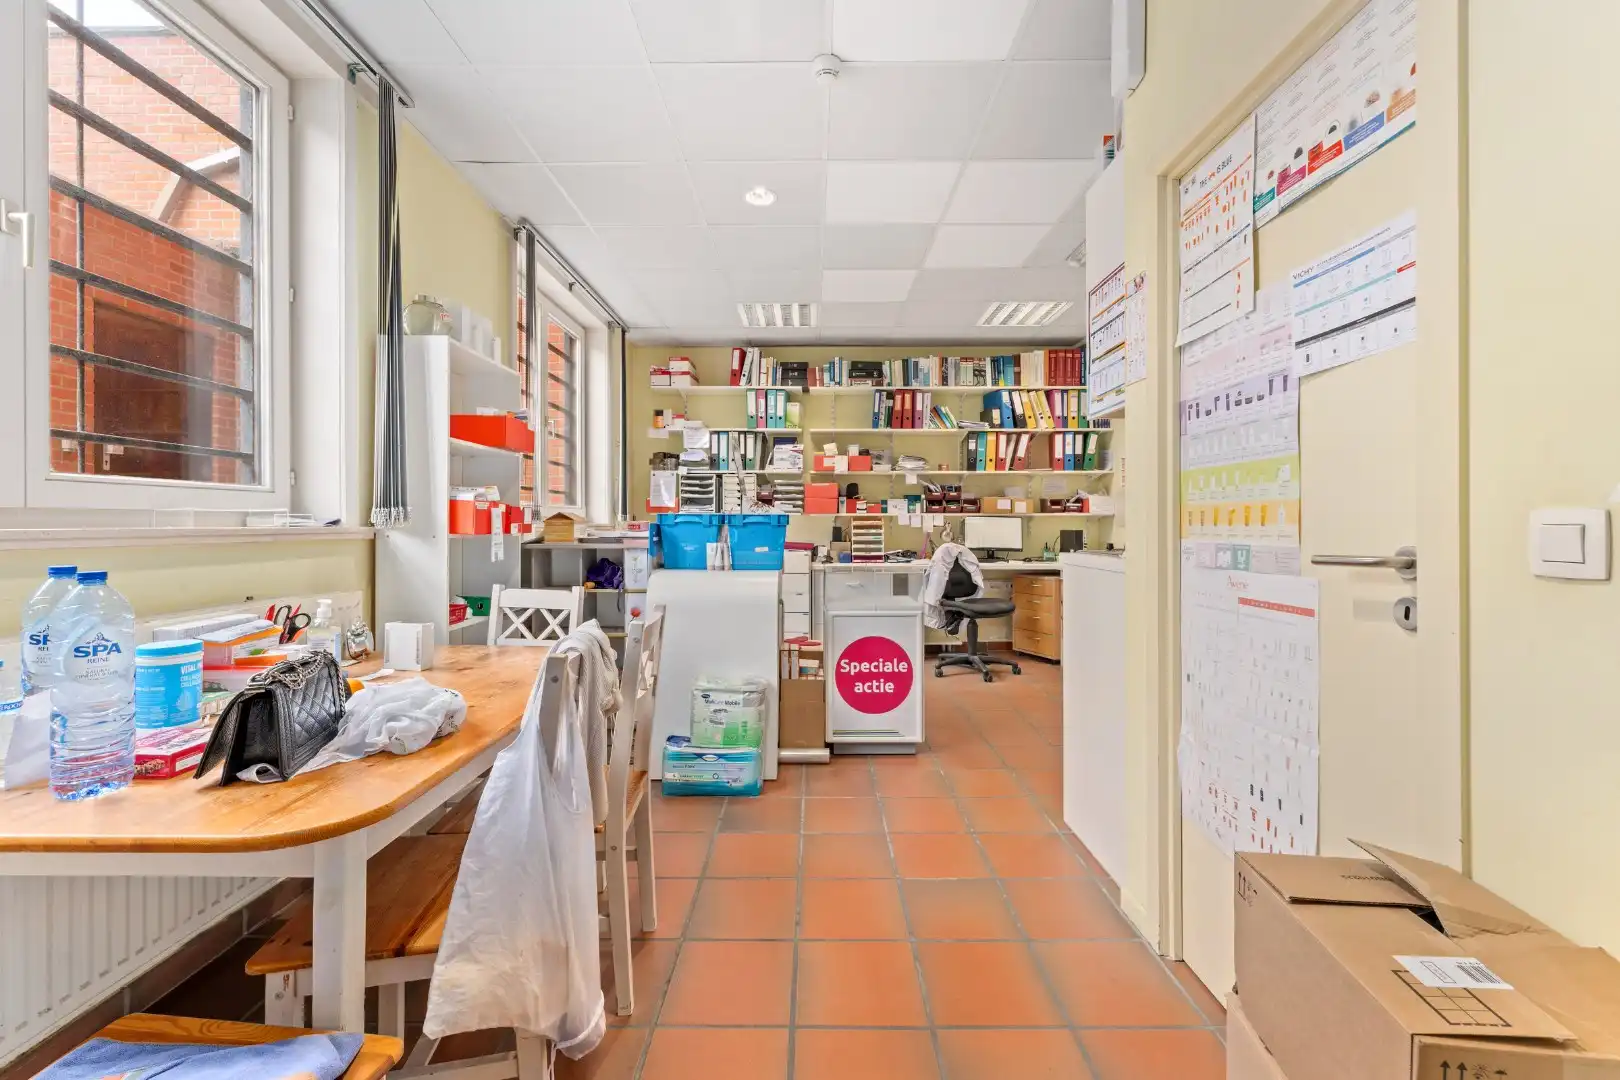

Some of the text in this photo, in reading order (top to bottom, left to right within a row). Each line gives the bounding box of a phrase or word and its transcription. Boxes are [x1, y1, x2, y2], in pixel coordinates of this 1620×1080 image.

[1292, 265, 1314, 280] VICHY
[73, 642, 122, 659] SPA
[840, 658, 909, 676] Speciale
[854, 678, 895, 693] actie
